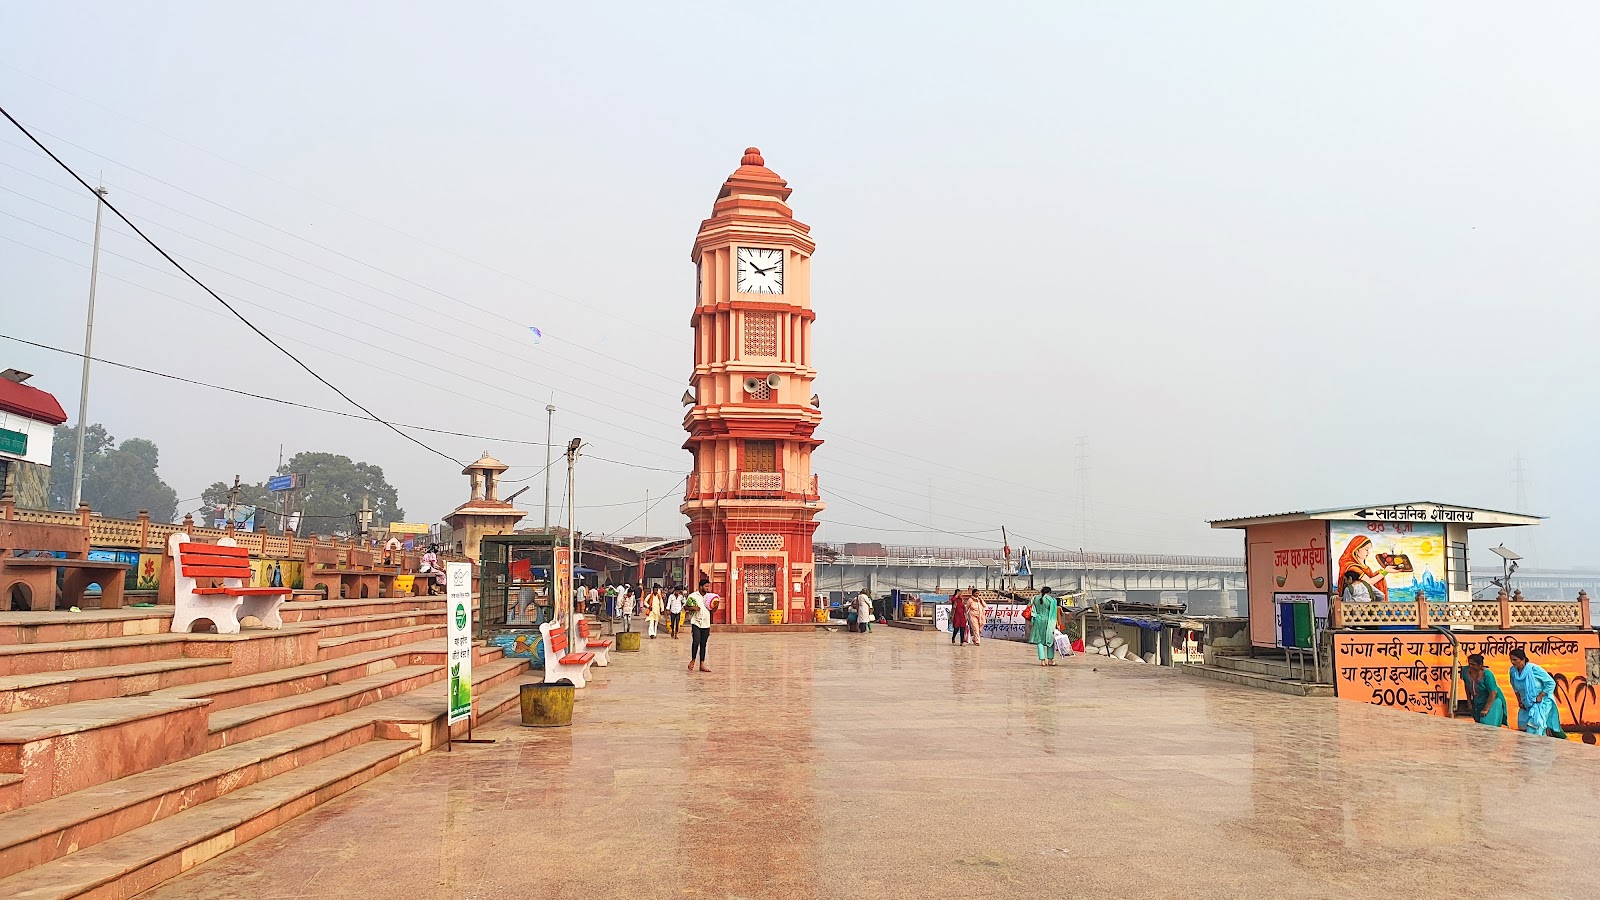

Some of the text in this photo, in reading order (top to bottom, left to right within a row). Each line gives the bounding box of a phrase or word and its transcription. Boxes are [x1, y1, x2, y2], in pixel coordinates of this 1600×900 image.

[1375, 504, 1475, 521] सार्वजनिक शौचालय
[1274, 549, 1289, 567] जय
[1340, 638, 1375, 656] गंगा
[1376, 638, 1404, 659] नदी
[1407, 641, 1425, 657] या
[1459, 641, 1477, 655] पर
[1529, 635, 1579, 657] प्लास्टिक
[1341, 667, 1358, 682] या
[1359, 666, 1389, 689] कूड़ा
[1389, 659, 1428, 685] इत्यादि
